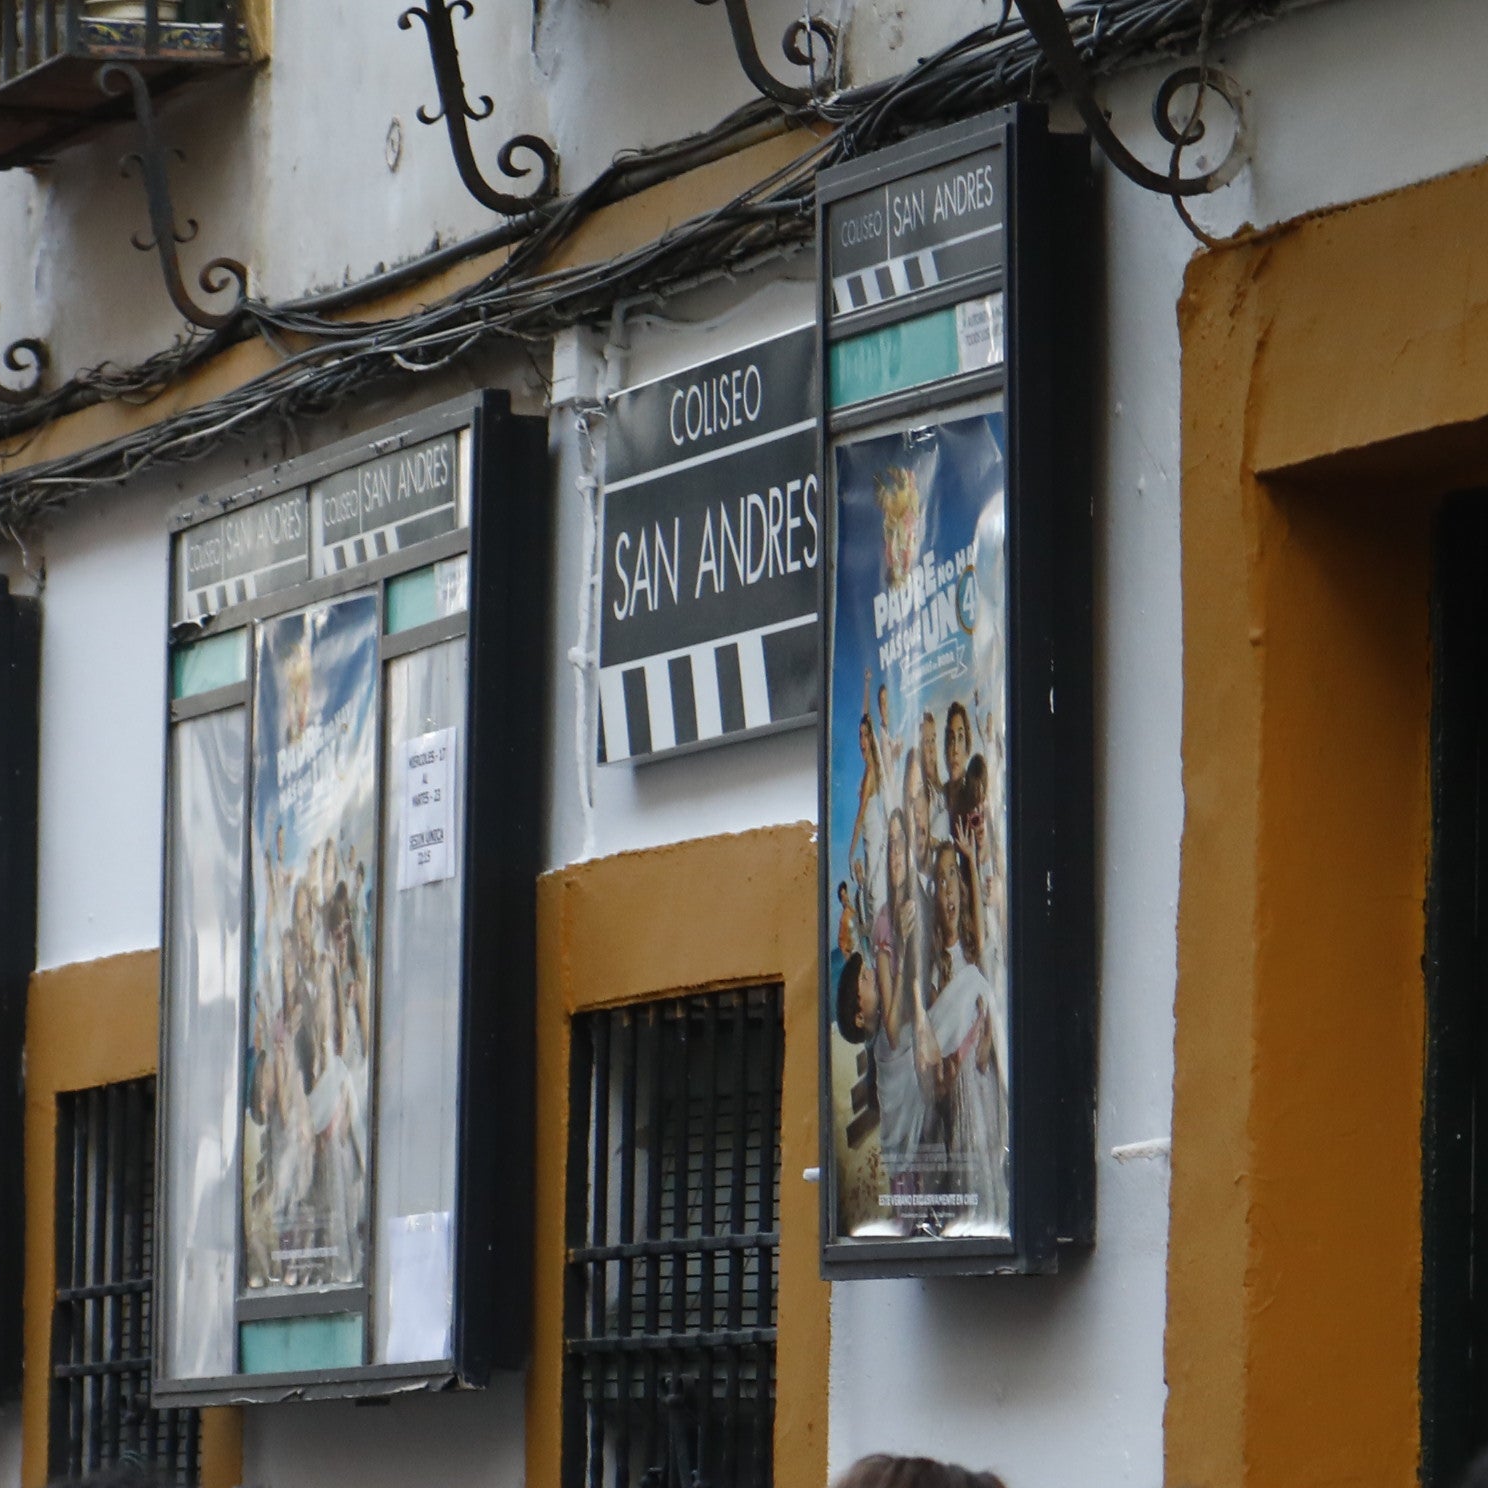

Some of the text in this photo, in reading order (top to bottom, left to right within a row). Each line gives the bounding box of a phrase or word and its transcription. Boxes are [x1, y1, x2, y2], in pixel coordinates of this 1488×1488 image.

[840, 165, 995, 248] COLISEO SAN ANDRES
[669, 364, 761, 446] COLISEO
[323, 443, 448, 528] COLISEO SAN ANDRES
[224, 520, 254, 562] SAN
[256, 498, 302, 549] ANDRES
[613, 473, 818, 621] SAN ANDRES
[873, 550, 937, 640] PADRE
